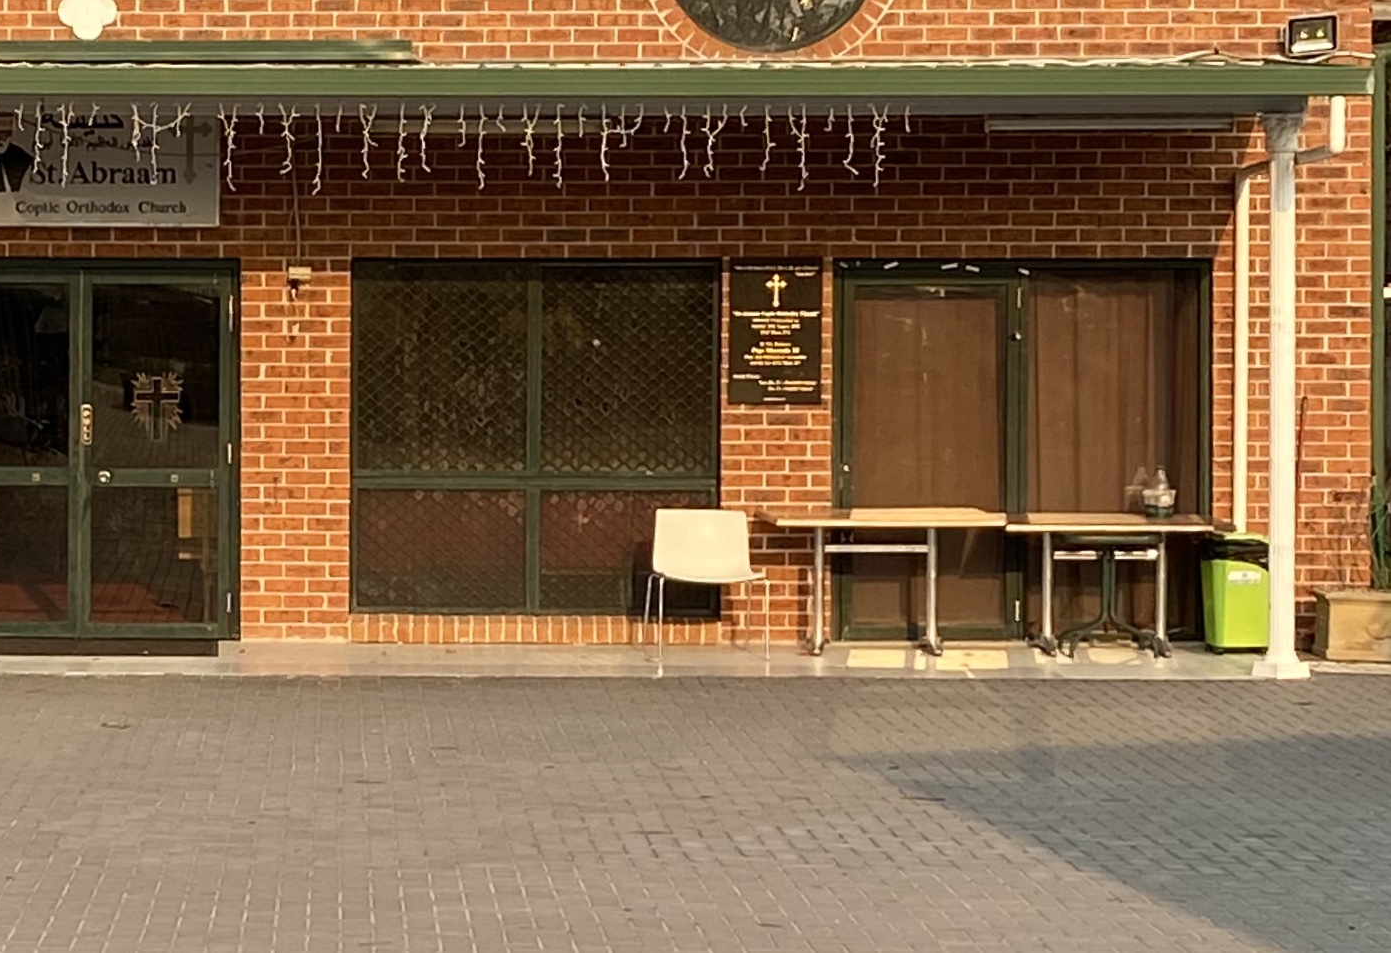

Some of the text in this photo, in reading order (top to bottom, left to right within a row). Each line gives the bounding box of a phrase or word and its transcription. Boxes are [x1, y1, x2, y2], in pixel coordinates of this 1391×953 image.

[29, 160, 177, 185] St. Abraam
[15, 200, 187, 217] Coptic Orthodox Church
